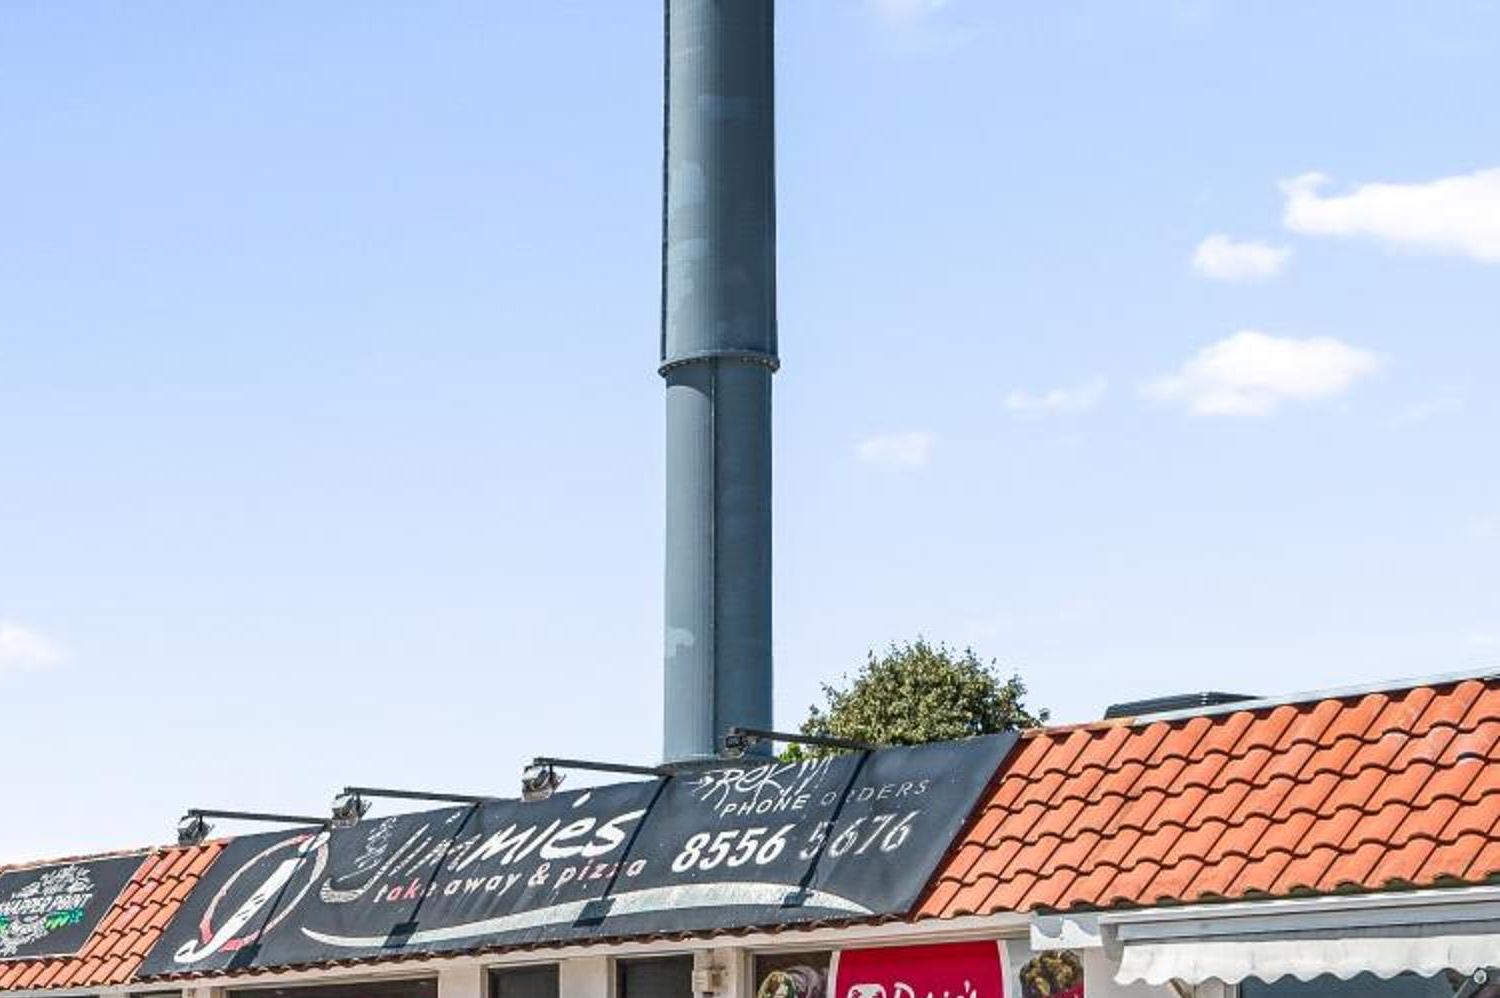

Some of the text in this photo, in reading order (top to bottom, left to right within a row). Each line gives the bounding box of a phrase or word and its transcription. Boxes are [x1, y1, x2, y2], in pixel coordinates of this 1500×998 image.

[720, 794, 809, 818] PHONE
[671, 810, 920, 872] 8556 5676
[444, 871, 520, 896] away
[528, 862, 550, 887] &
